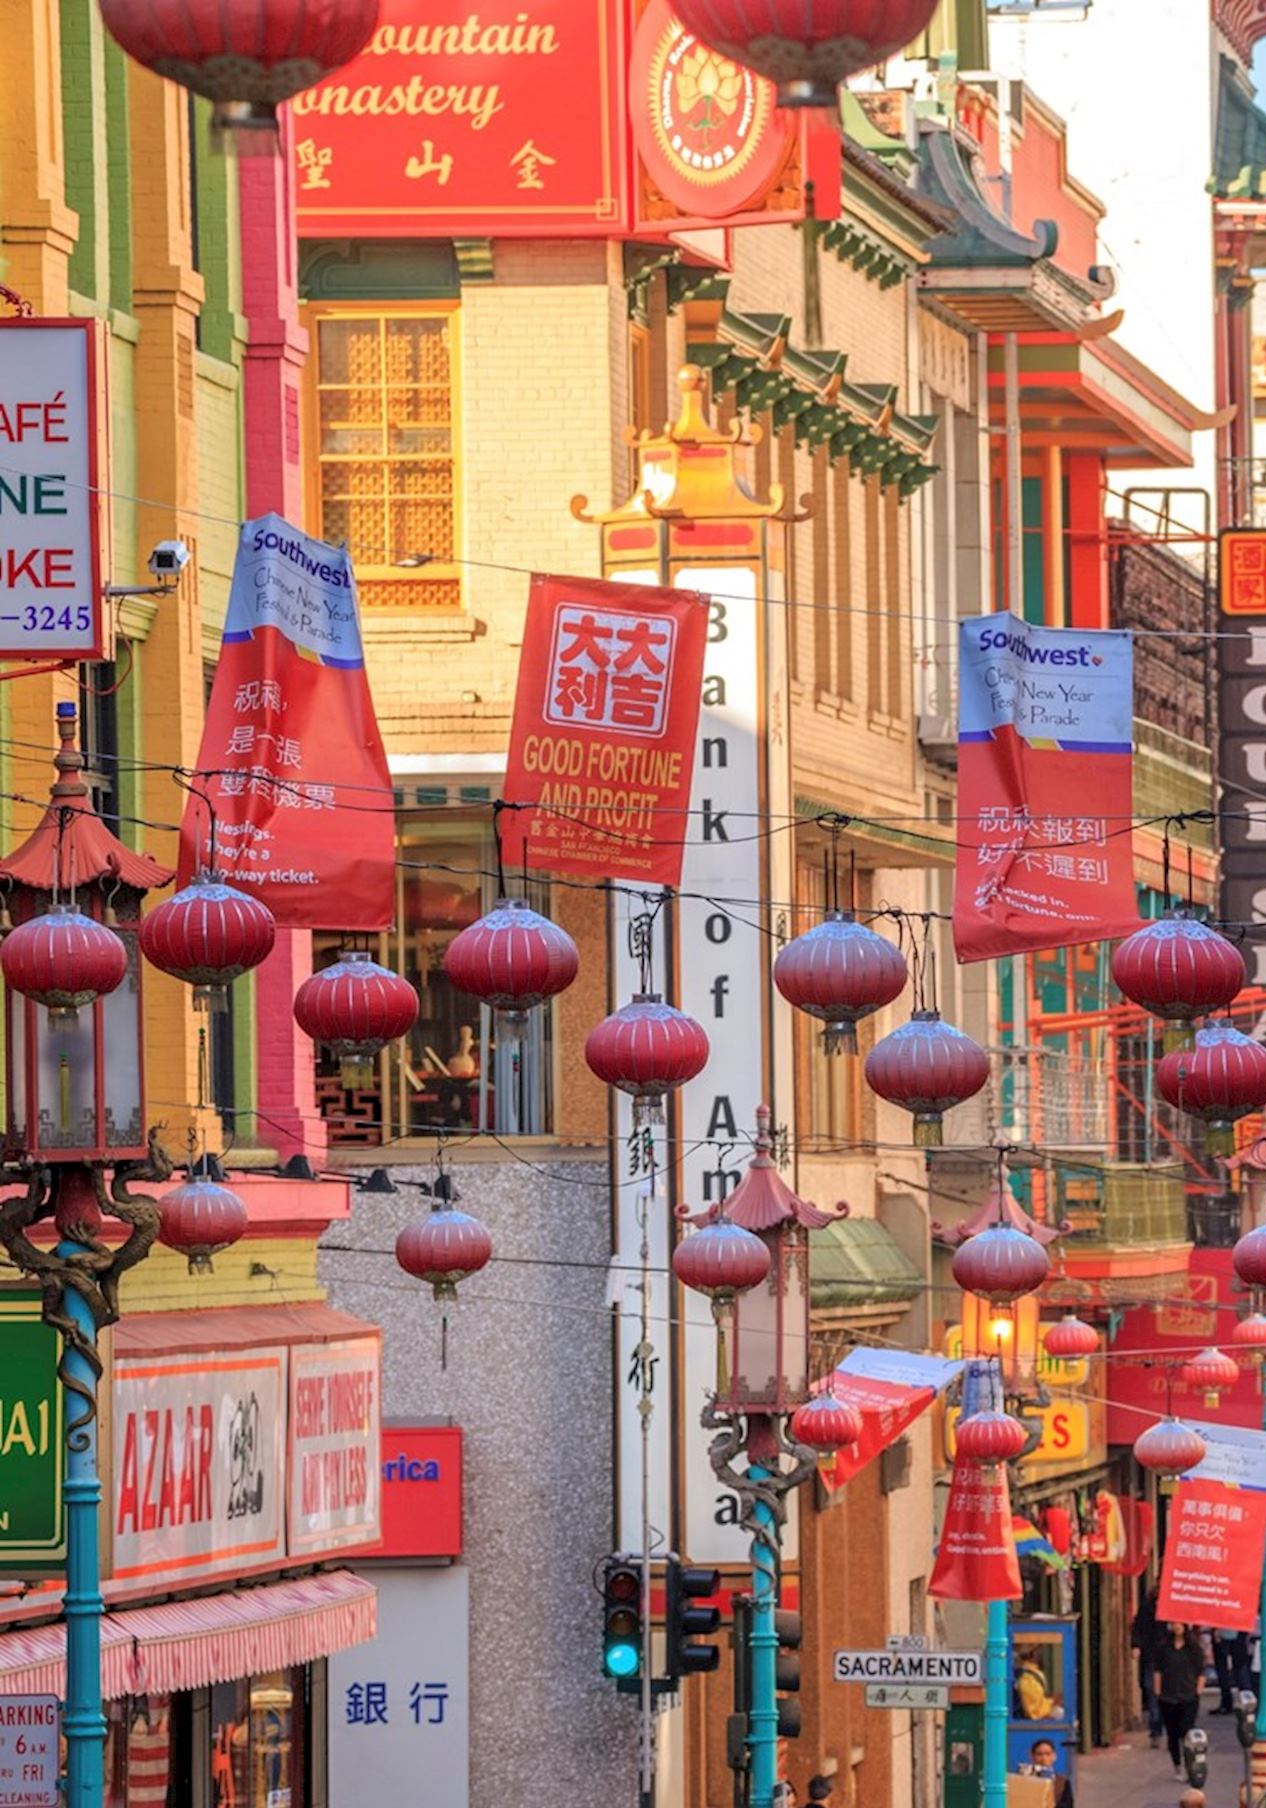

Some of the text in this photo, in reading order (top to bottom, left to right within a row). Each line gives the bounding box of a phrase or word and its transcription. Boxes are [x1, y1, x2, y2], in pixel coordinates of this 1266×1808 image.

[361, 13, 560, 55] ountain
[292, 75, 504, 130] onastery
[0, 549, 75, 588] KE
[253, 529, 352, 589] Southwest
[253, 566, 356, 623] Chinese New Year
[300, 614, 343, 645] Parade
[979, 629, 1091, 668] Southwest
[1020, 680, 1096, 703] New Year
[1030, 704, 1081, 726] Parade
[225, 724, 302, 770] 是一張
[523, 735, 683, 790] GOOD FORTUNE
[536, 781, 658, 830] AND PROFIT
[269, 867, 320, 884] ticket.
[704, 912, 733, 1019] of
[117, 1404, 215, 1535] AZAAR
[381, 1452, 440, 1482] rica
[838, 1657, 978, 1677] SACRAMENTO
[345, 1681, 450, 1726] 銀行
[16, 1734, 27, 1755] 6
[23, 1764, 44, 1781] FRI
